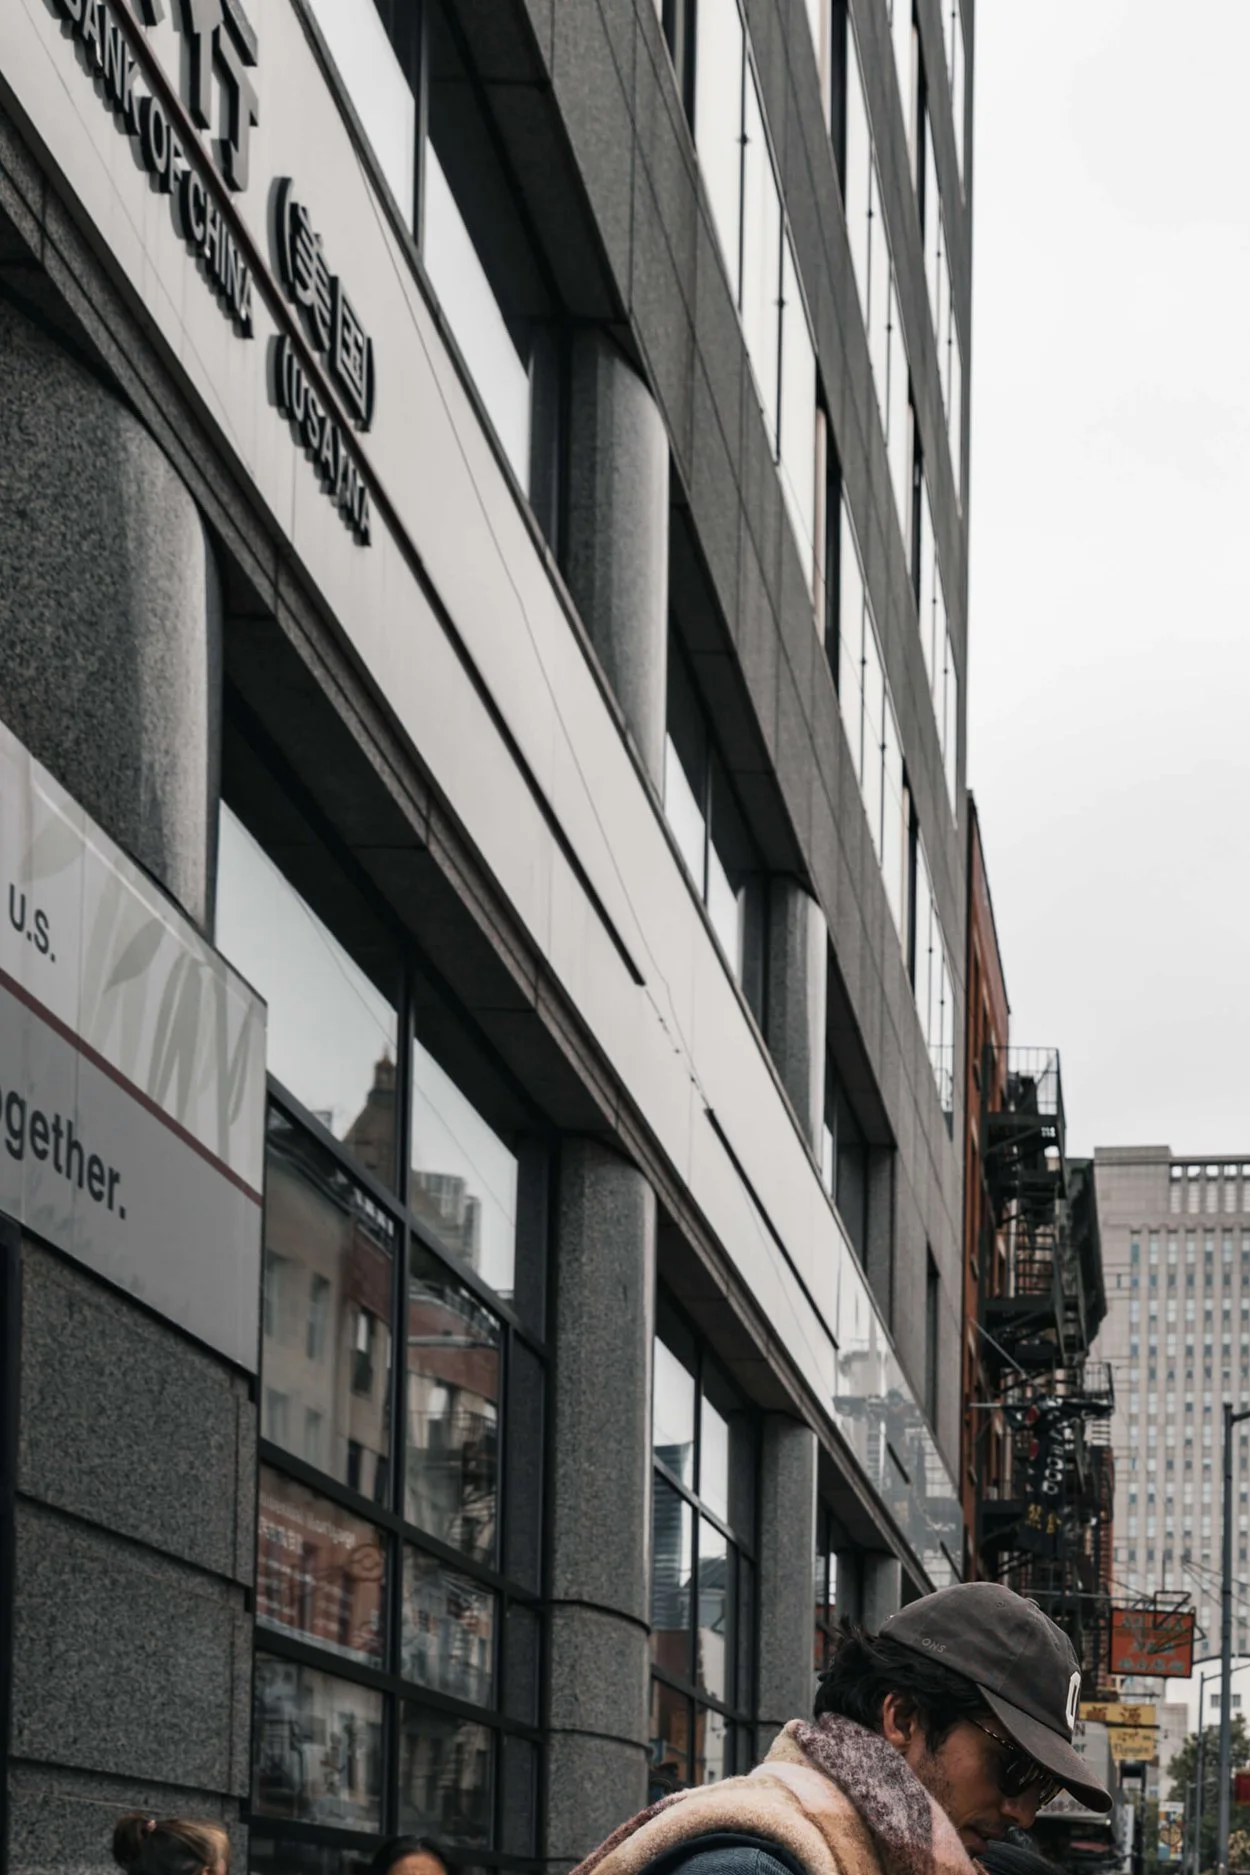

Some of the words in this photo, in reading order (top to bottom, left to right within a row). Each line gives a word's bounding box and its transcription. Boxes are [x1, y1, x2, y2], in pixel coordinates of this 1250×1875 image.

[181, 169, 253, 339] CHINA
[9, 882, 56, 963] U.S.
[0, 1089, 126, 1221] gether.
